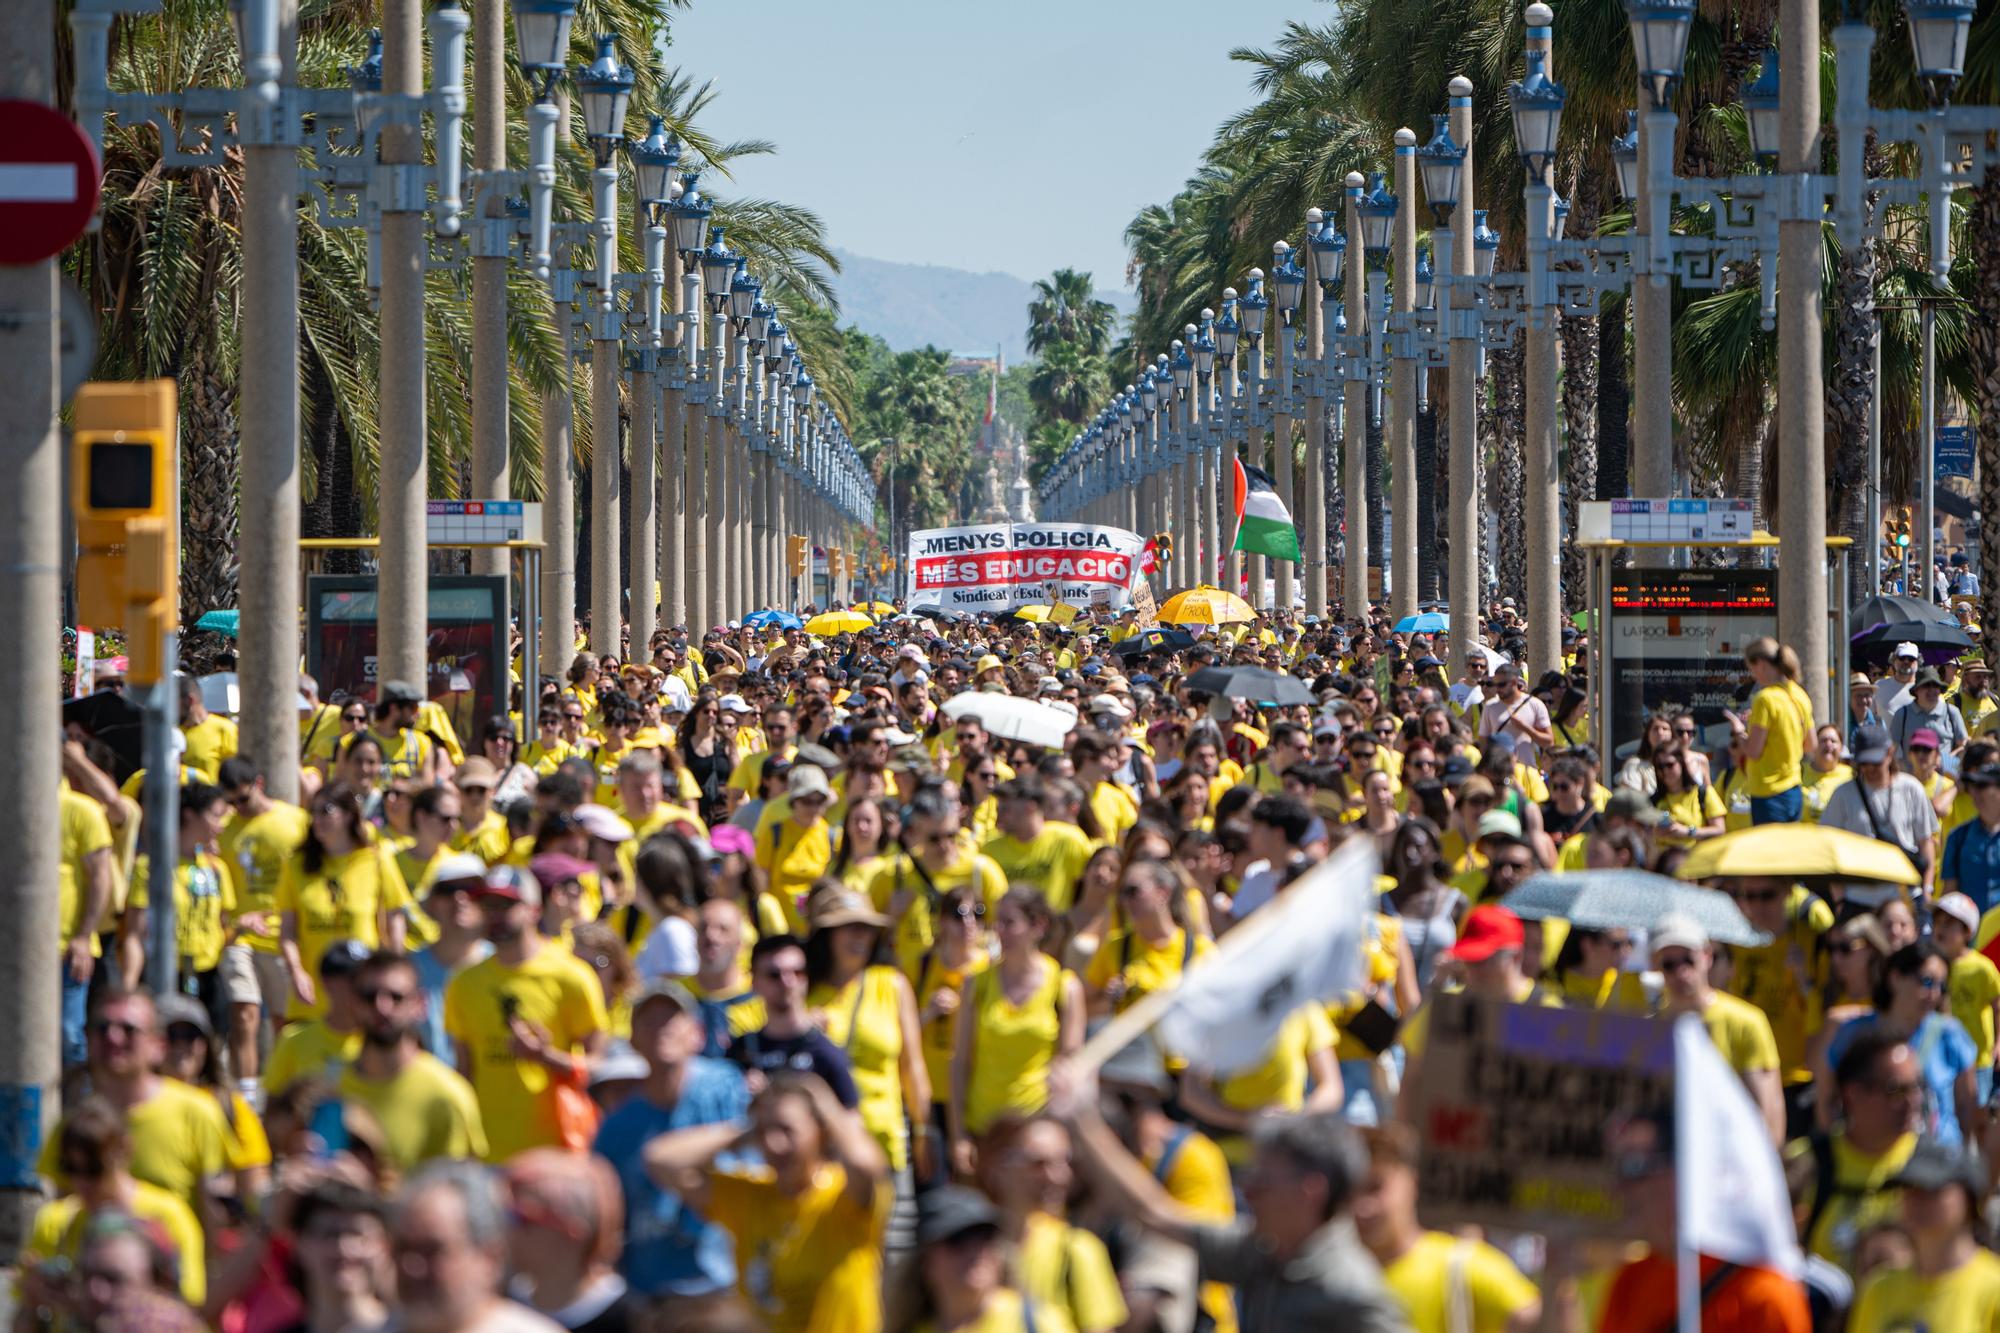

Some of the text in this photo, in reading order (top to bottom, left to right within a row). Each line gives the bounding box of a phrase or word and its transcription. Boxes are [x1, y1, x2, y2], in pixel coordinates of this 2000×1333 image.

[927, 531, 1112, 553] MENYS POLICIA
[922, 559, 979, 584] MÉS
[985, 553, 1127, 579] EDUCACIÓ
[953, 585, 1088, 604] Sindicat d'Estunts
[1183, 604, 1210, 617] PROU
[1623, 626, 1637, 636] LA
[437, 662, 451, 674] 16
